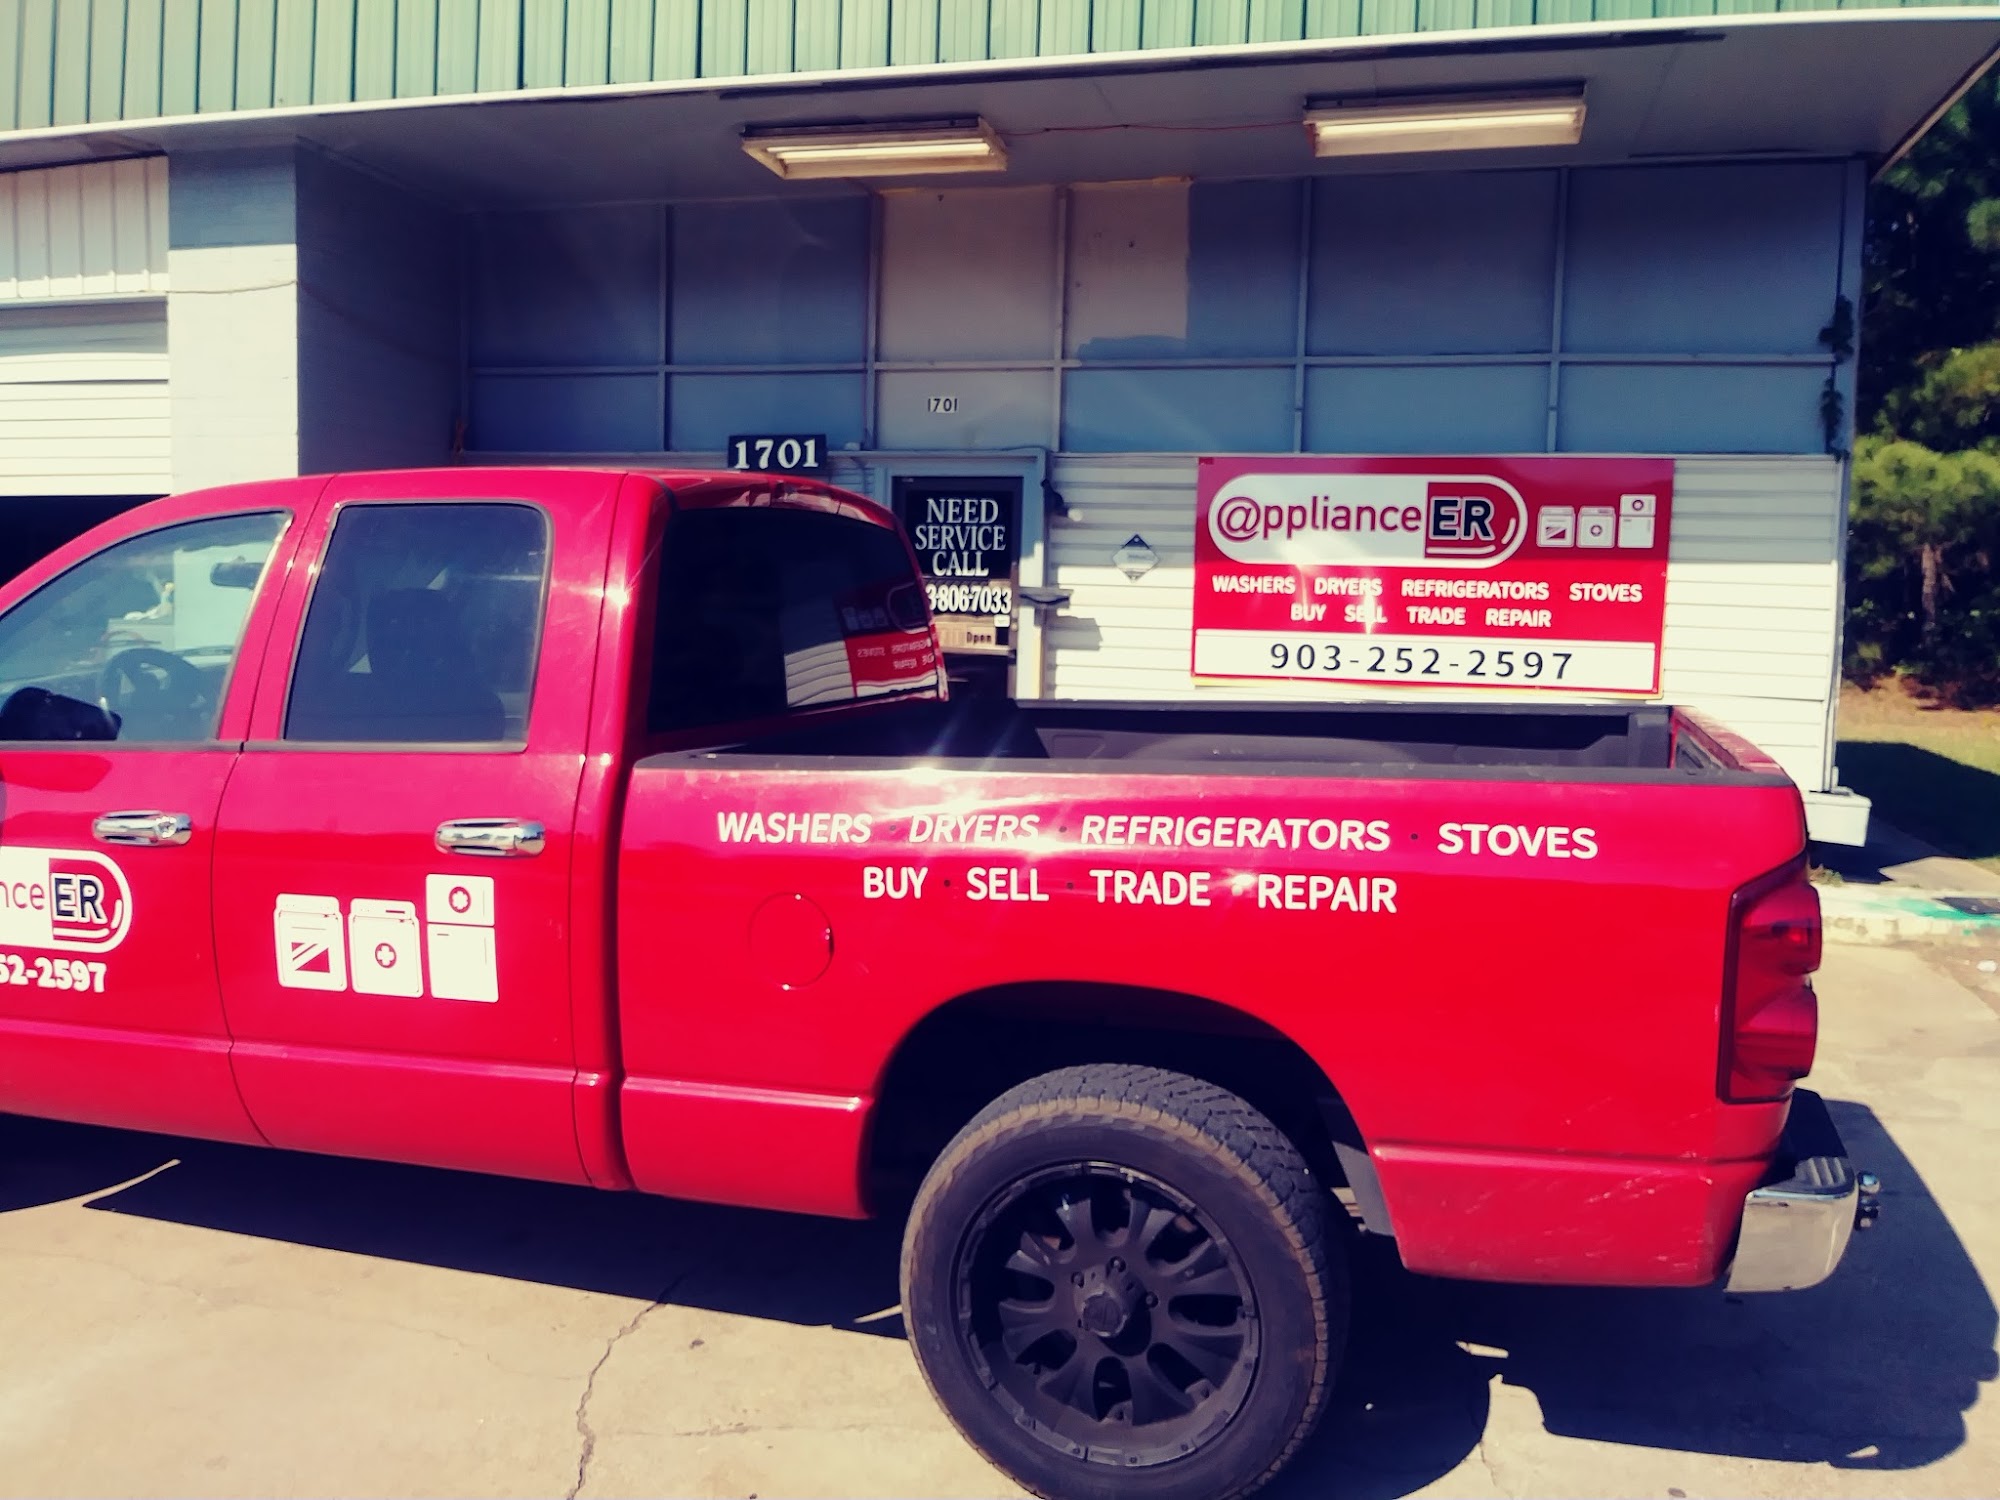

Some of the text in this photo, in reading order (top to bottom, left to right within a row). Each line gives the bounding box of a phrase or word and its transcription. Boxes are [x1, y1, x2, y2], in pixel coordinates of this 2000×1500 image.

[928, 397, 958, 413] 1701
[735, 438, 820, 470] 1701
[926, 498, 999, 524] NEED
[915, 525, 1006, 551] SERVICE
[932, 551, 990, 577] CALL
[1212, 574, 1643, 603] WASHERS DRYERS REFRIGERATORS STOVES
[1290, 604, 1326, 622] BUY
[1406, 606, 1467, 626] TRADE
[1485, 608, 1552, 628] REPAIR
[1270, 643, 1574, 681] 903-252-2597
[717, 811, 1599, 860] WASHERS DRYERS REFRIGERATORS STOVES
[862, 865, 1398, 914] BUY SELL TRADE REPAIR
